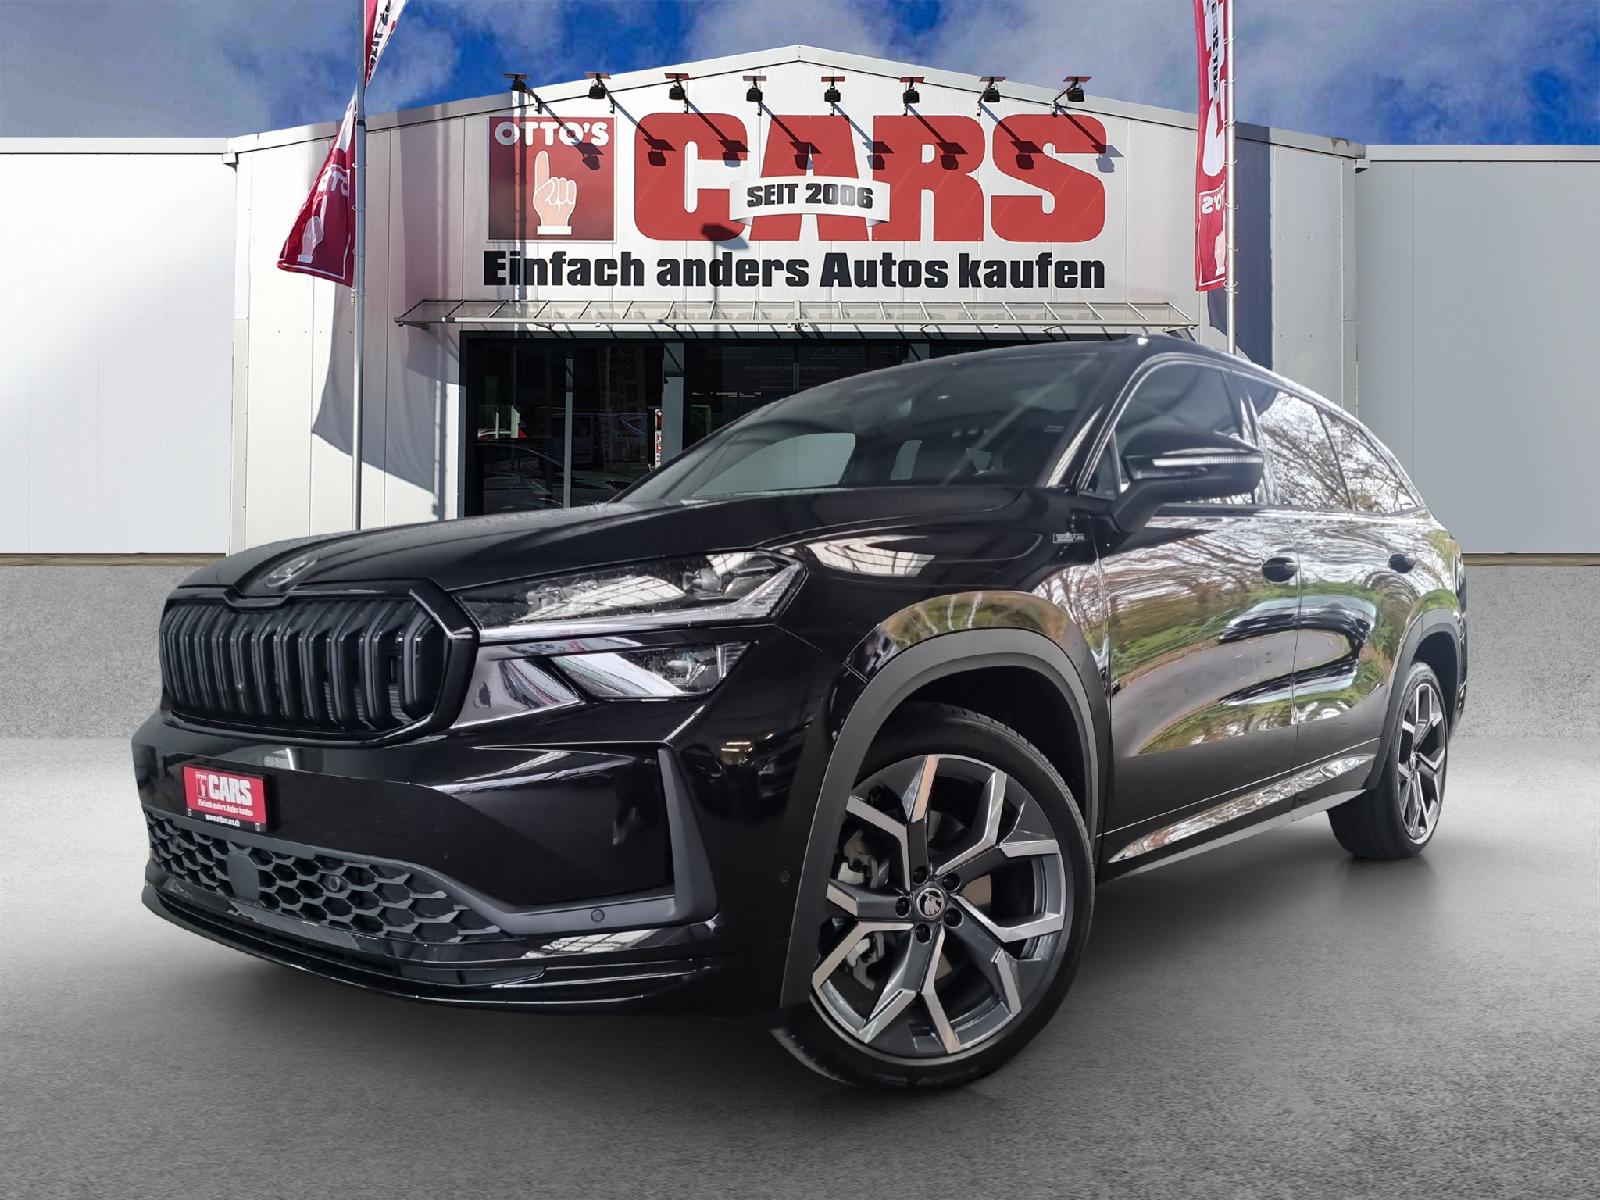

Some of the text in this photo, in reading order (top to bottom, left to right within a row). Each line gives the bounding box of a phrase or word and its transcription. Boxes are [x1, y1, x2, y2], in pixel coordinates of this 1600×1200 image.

[494, 121, 610, 147] OTTO'S
[634, 112, 1107, 243] CARS
[746, 182, 874, 210] SEIT 2006
[483, 250, 1105, 289] Einfach anders Autos kaufen
[208, 774, 252, 806] CARS
